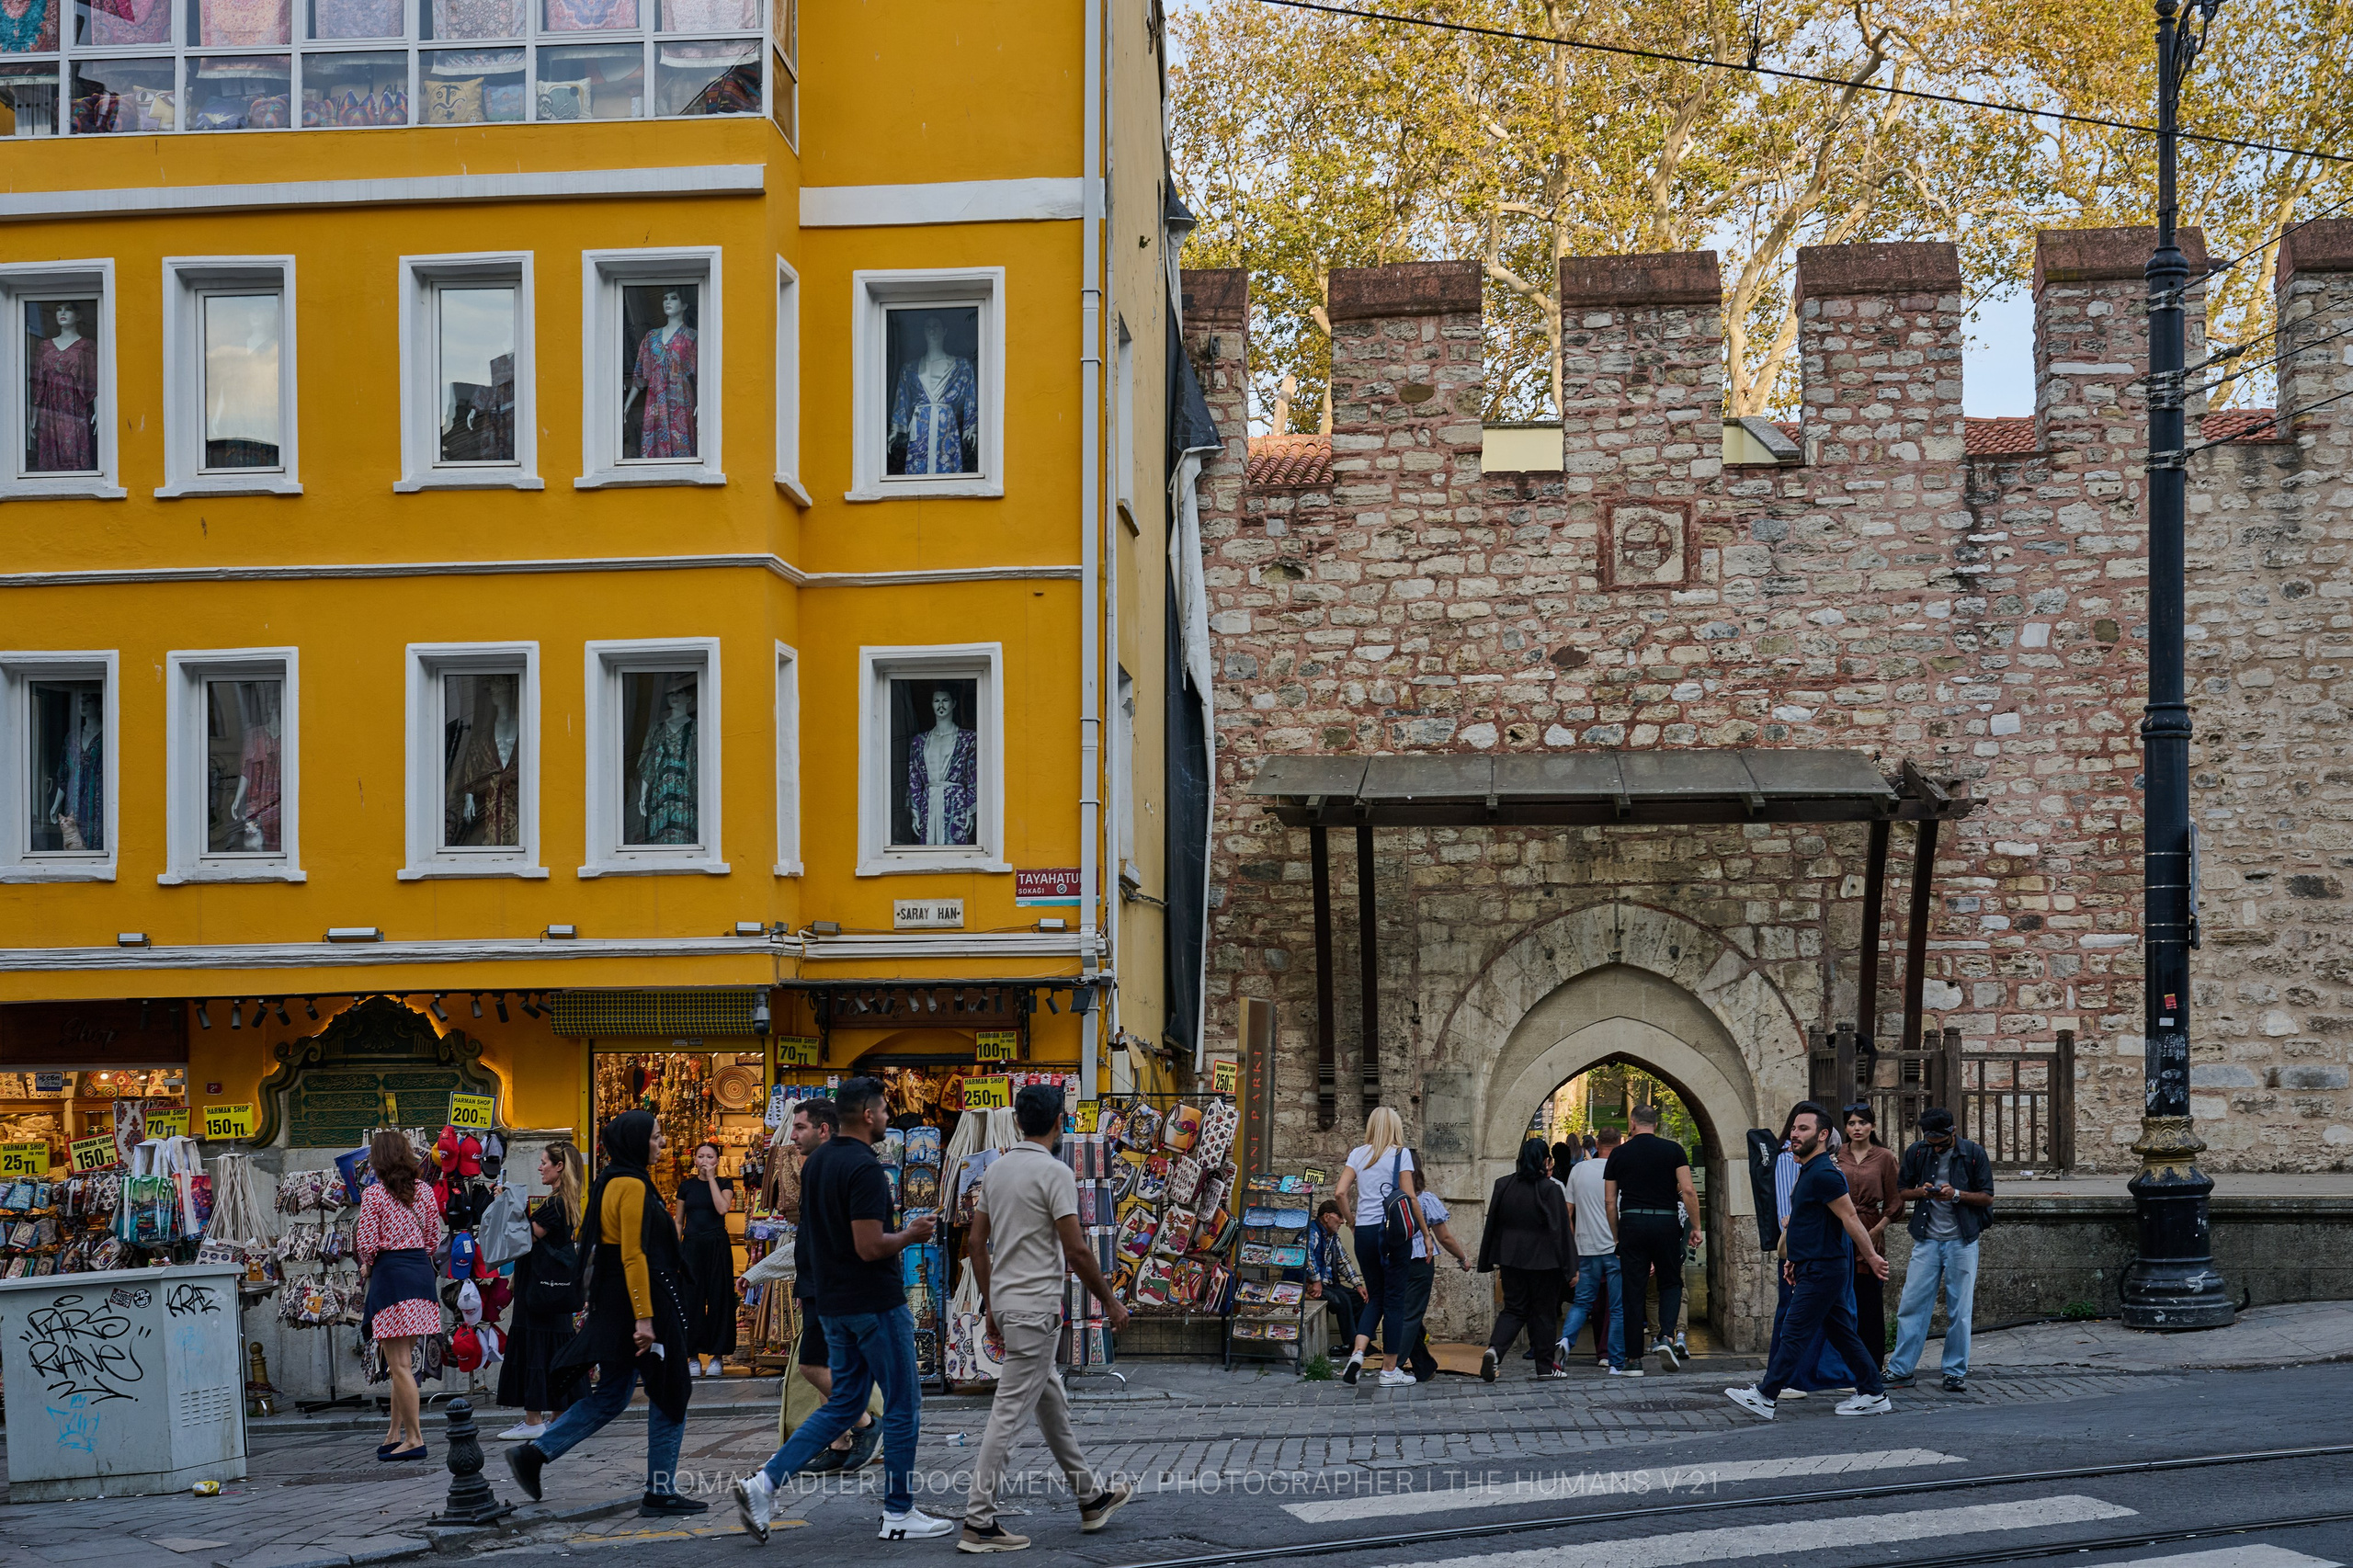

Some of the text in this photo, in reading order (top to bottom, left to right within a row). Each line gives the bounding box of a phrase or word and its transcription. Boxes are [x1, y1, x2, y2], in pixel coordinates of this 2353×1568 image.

[1018, 873, 1081, 884] TAYAHATU
[901, 907, 957, 920] SARAY HAN
[780, 1046, 810, 1064] 70 TL
[977, 1043, 1013, 1060] 100 TL
[1215, 1074, 1229, 1091] 250
[965, 1090, 1006, 1108] 250 TL
[453, 1108, 478, 1123] 200
[147, 1119, 164, 1135] 70
[206, 1119, 247, 1136] 150 TL
[73, 1140, 97, 1150] HARMAN
[97, 1136, 113, 1144] SHOP
[1247, 1051, 1261, 1241] GLANE PARKI
[4, 1154, 39, 1174] 25 TL
[76, 1148, 116, 1169] 150 TL
[1307, 1174, 1319, 1184] 100
